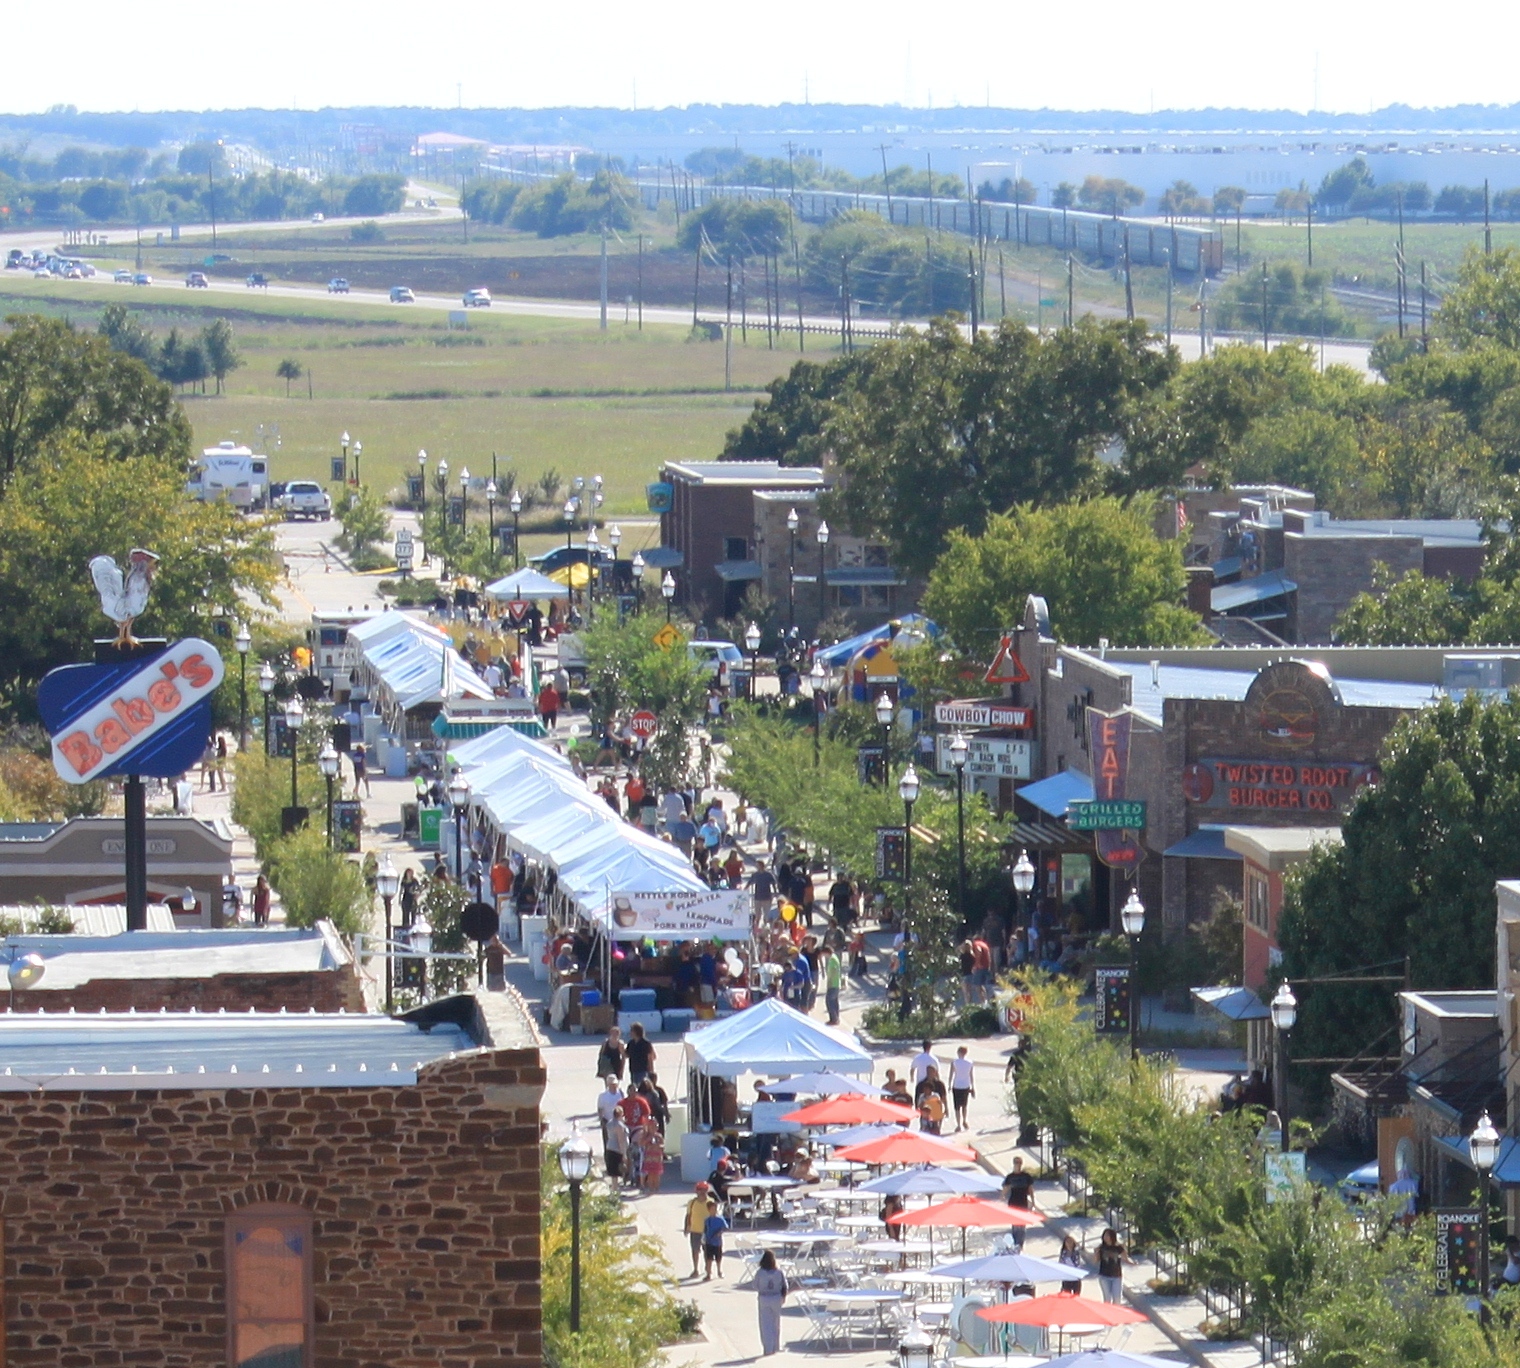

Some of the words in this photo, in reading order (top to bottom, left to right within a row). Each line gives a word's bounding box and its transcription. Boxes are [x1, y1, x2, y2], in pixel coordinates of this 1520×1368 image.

[57, 654, 214, 777] Babe's
[940, 707, 987, 723] COWBOY
[991, 710, 1026, 726] CHOW
[632, 718, 656, 732] STOP
[1214, 761, 1295, 785] TWISTED
[1302, 767, 1349, 788] ROOT
[1229, 788, 1300, 808] BURGER
[1308, 789, 1337, 811] CO.
[1079, 803, 1142, 815] GRILLED
[1079, 816, 1142, 827] BURGERS
[634, 892, 667, 900] KETTLE
[675, 899, 704, 911] PEACH
[705, 893, 721, 903] TEA
[686, 911, 734, 927] LEMONADE
[1096, 969, 1130, 978] ROANOKE
[1096, 976, 1106, 1029] CELEBRATE
[1437, 1213, 1480, 1224] ROANOKE
[1436, 1223, 1449, 1291] CELEBRATE
